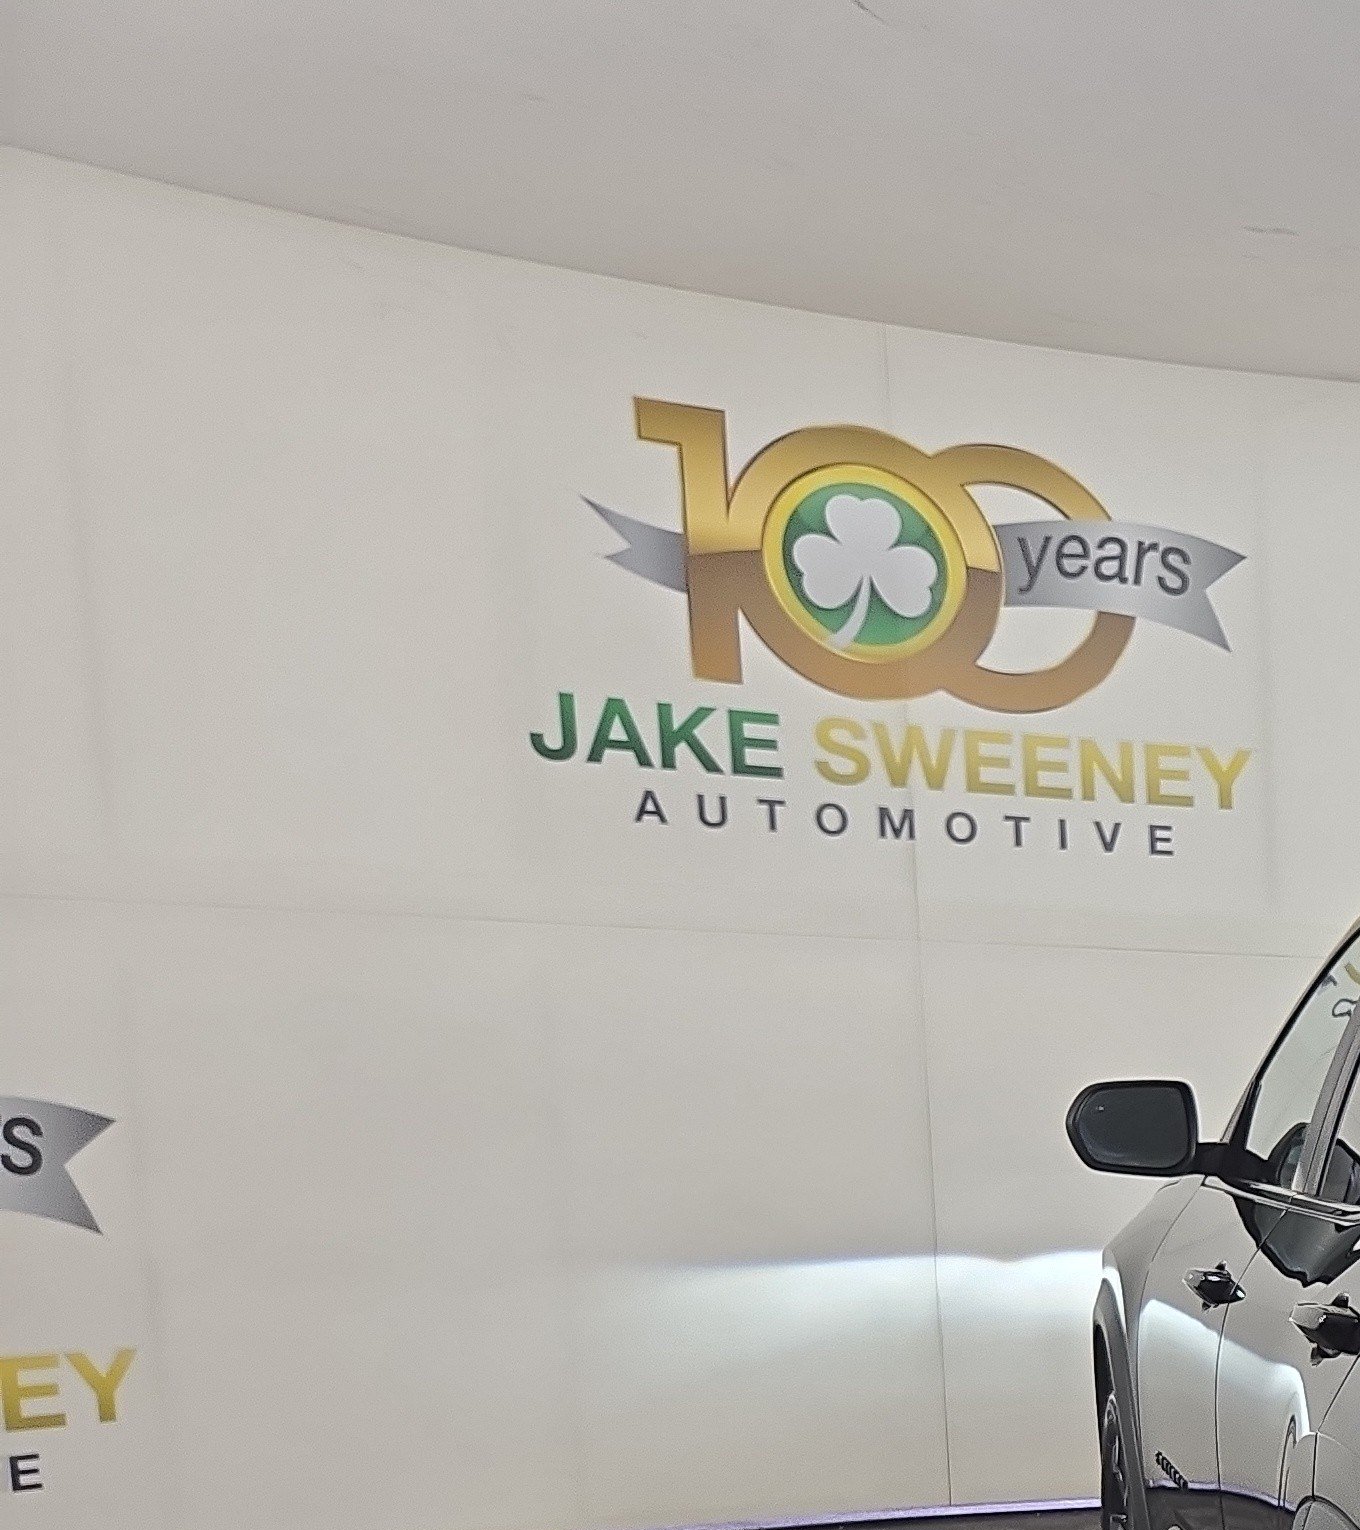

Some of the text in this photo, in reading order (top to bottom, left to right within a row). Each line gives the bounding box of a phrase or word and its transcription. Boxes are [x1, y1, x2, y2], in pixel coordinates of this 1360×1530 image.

[633, 397, 1136, 714] 100
[1017, 526, 1192, 596] years
[530, 692, 1252, 810] JAKE SWEENEY
[634, 790, 1175, 856] AUTOMOTIVE
